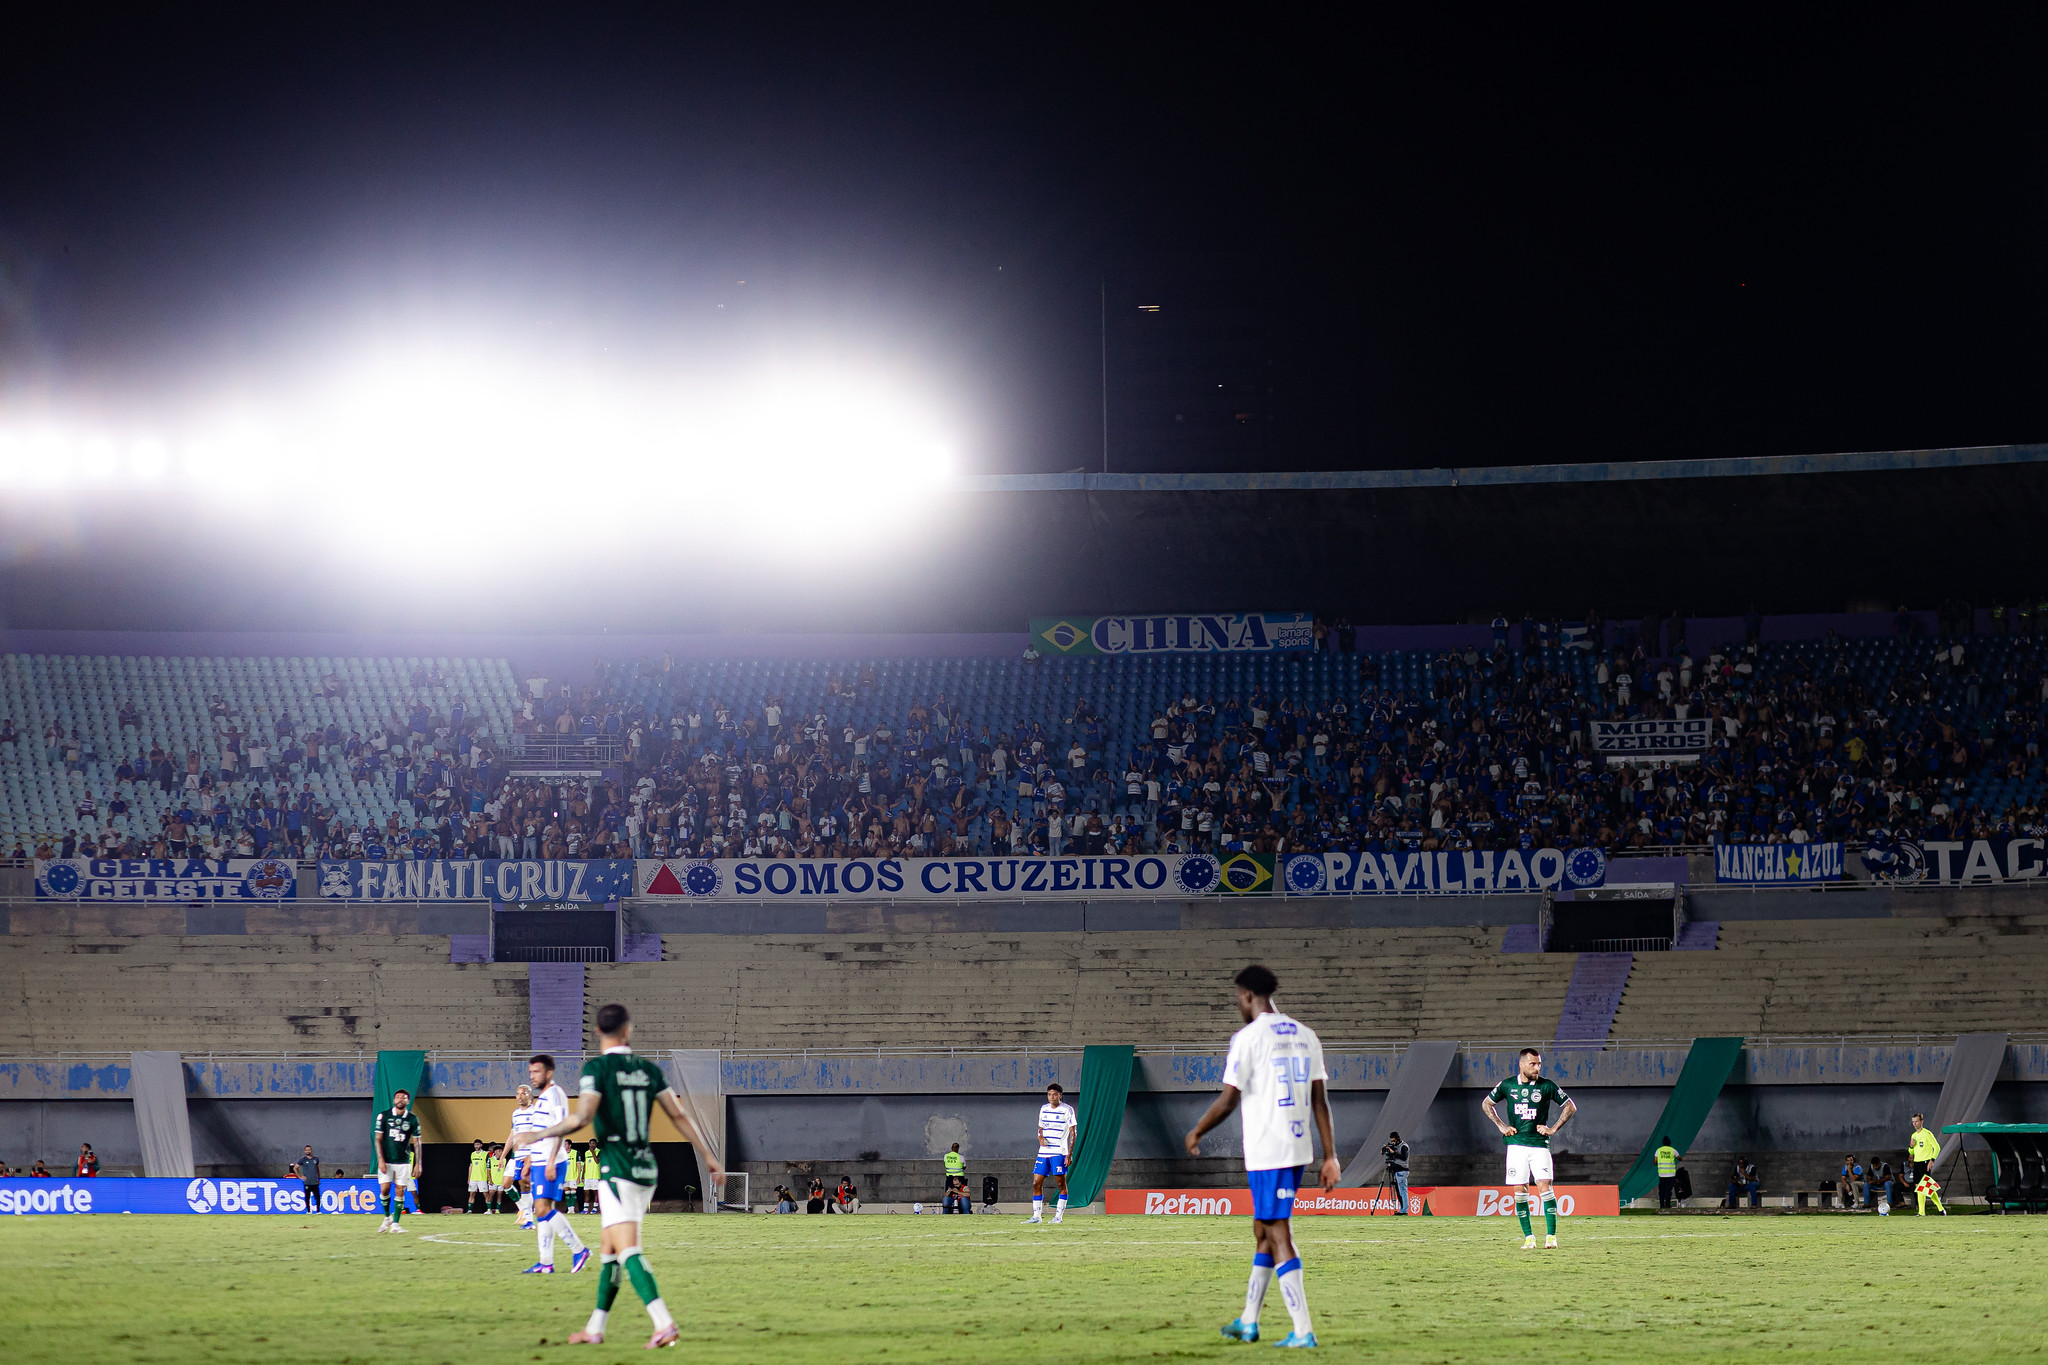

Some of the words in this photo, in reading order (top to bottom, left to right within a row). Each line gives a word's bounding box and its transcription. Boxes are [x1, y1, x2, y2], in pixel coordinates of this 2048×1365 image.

[1092, 613, 1274, 653] CHINA
[1278, 627, 1311, 638] tamara
[1279, 637, 1310, 648] sports
[1598, 720, 1706, 735] MOTO
[1598, 734, 1706, 749] ZEIROS
[90, 859, 242, 878] GERAL
[1717, 844, 1786, 880] MANCHA
[1800, 842, 1841, 880] AZUL
[735, 860, 904, 895] SOMOS
[920, 858, 1168, 893] CRUZEIRO
[1179, 854, 1216, 866] CRUZEIRO
[1203, 869, 1220, 893] CLUBE
[90, 880, 243, 899] CELESTE
[1623, 889, 1649, 899] SAÍDA
[554, 902, 579, 910] SAÍDA
[1271, 1056, 1311, 1107] 34
[621, 1089, 648, 1142] 11
[1144, 1192, 1232, 1215] Betano
[1293, 1198, 1315, 1211] Copa
[1315, 1196, 1357, 1210] Betano
[1357, 1198, 1369, 1210] do
[1476, 1189, 1575, 1216] Beao
